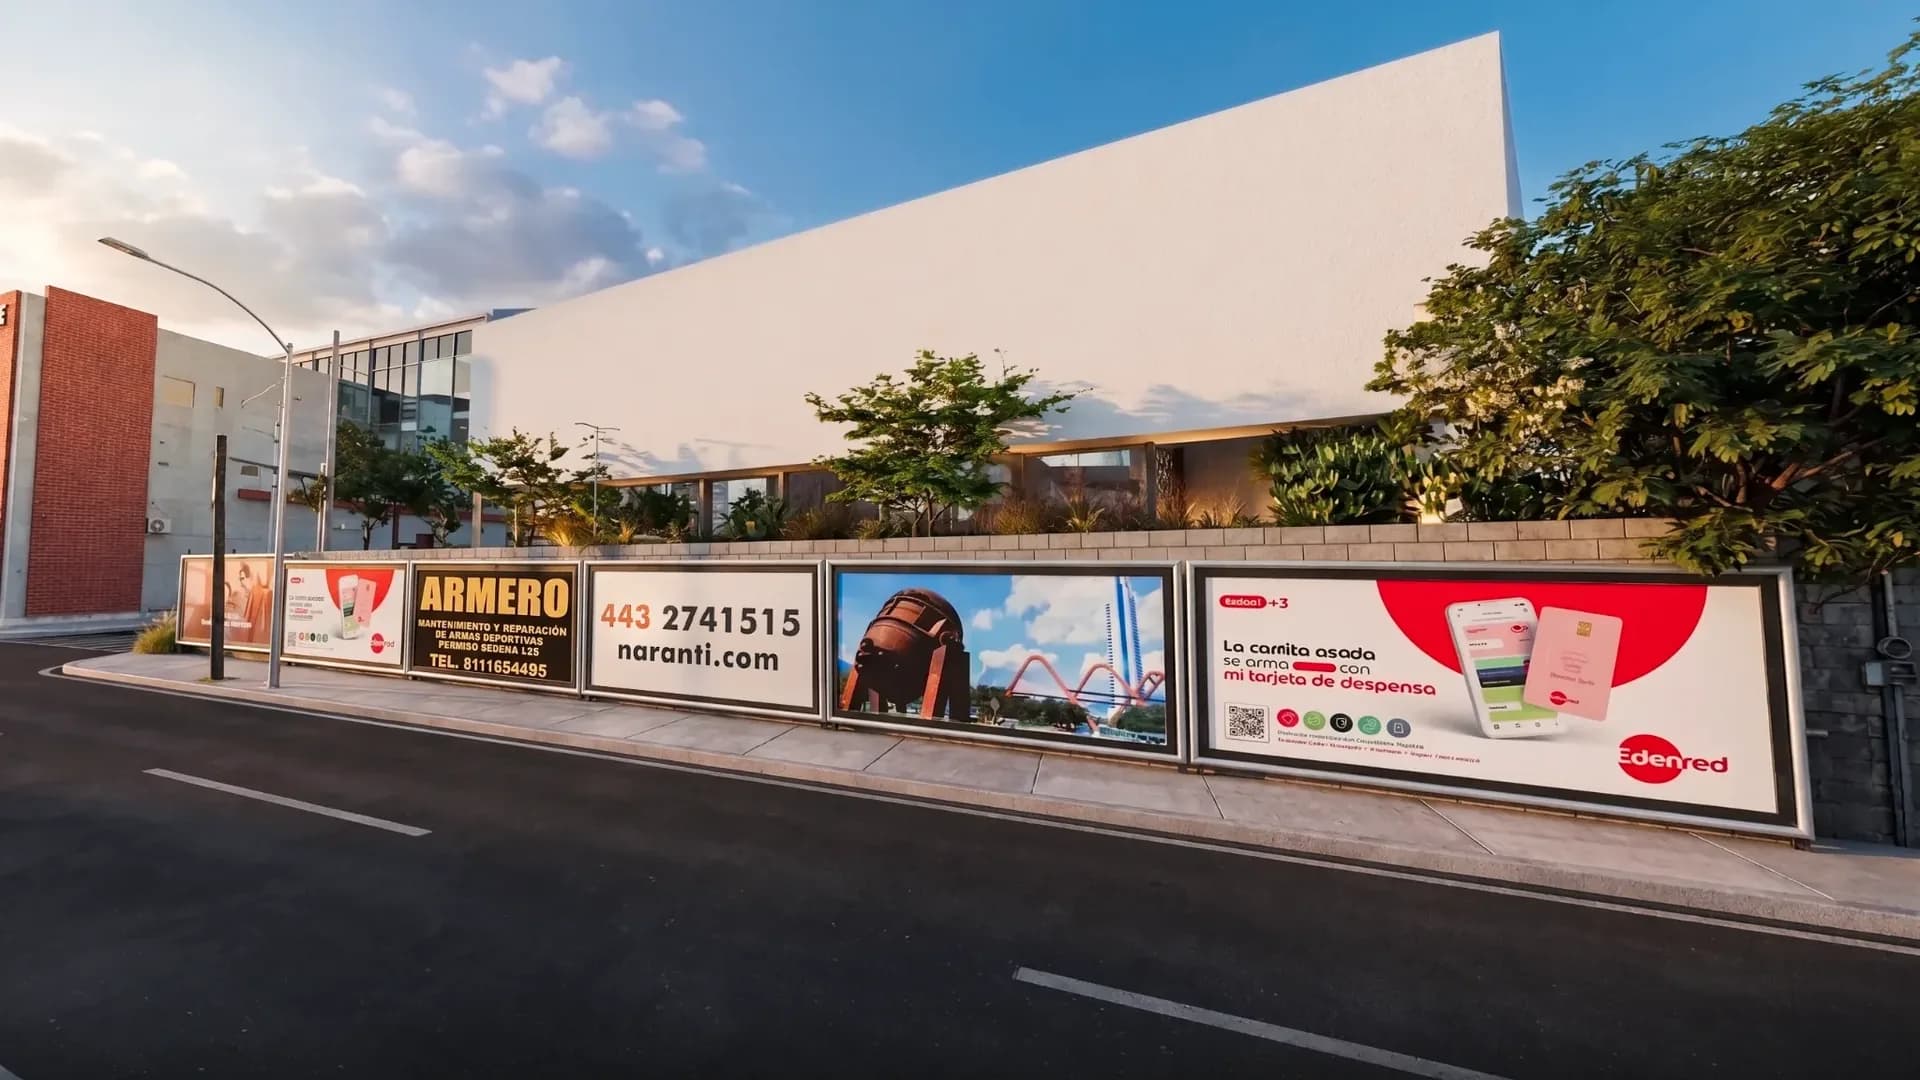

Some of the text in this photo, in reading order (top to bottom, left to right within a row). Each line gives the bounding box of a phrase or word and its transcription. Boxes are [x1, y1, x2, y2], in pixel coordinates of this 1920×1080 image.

[420, 576, 569, 618] ARMERO
[418, 619, 567, 636] MANTENIMIENTO Y REPARACIÓN
[600, 603, 800, 637] 443 2741515
[435, 629, 544, 646] DE ARMAS DEPORTIVAS
[438, 640, 478, 651] PERMISO
[481, 643, 519, 655] SEDENA
[618, 642, 779, 671] naranti.com
[1223, 640, 1376, 661] La carnita asada
[430, 653, 548, 678] TEL. 8111654495
[1223, 656, 1371, 675] se arma con
[1224, 669, 1437, 696] mi tarjeta de despensa
[1619, 747, 1728, 773] Edenred
